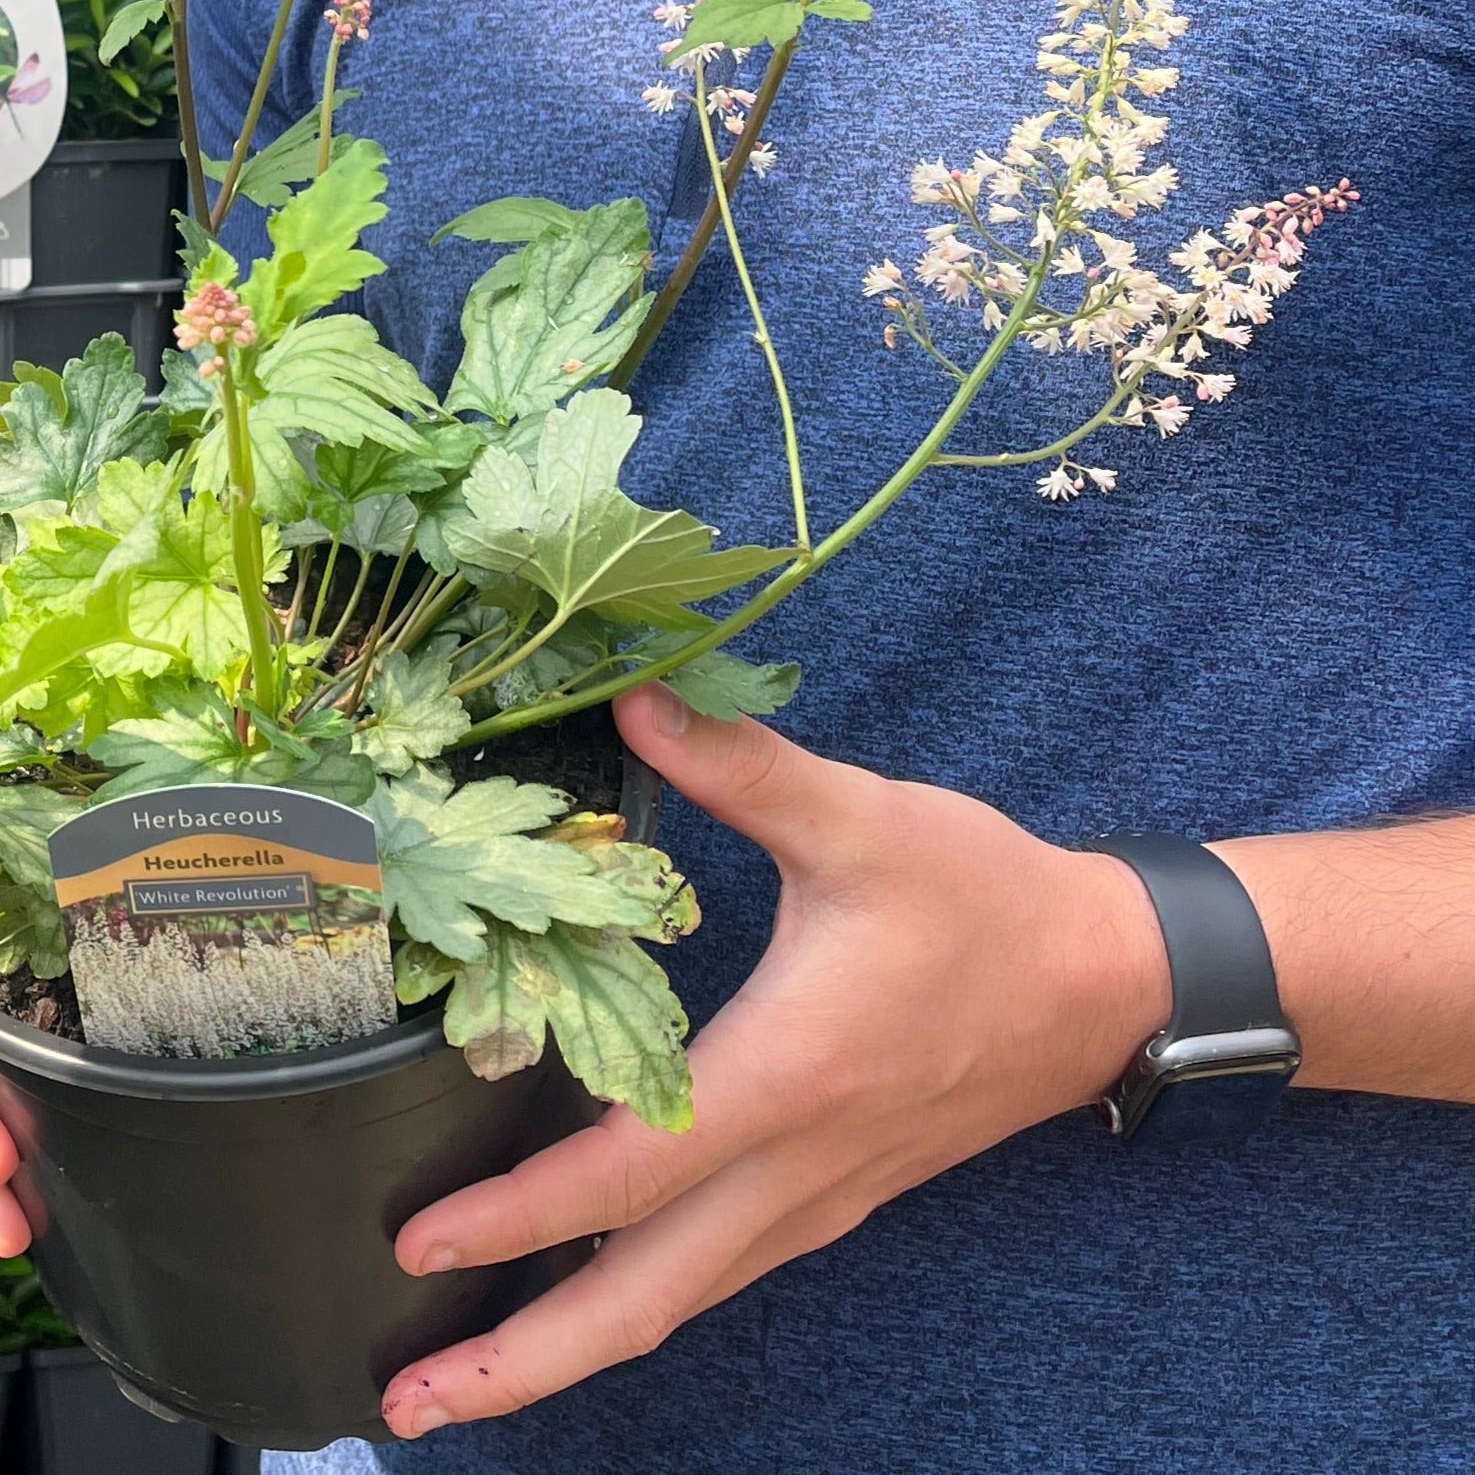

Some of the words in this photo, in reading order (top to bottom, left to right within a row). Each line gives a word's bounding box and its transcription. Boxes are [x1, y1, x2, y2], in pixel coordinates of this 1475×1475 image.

[132, 808, 284, 830] Herbaceous
[144, 850, 285, 871] Heucherella
[135, 890, 191, 905] 'White
[195, 885, 291, 903] Revolution'
